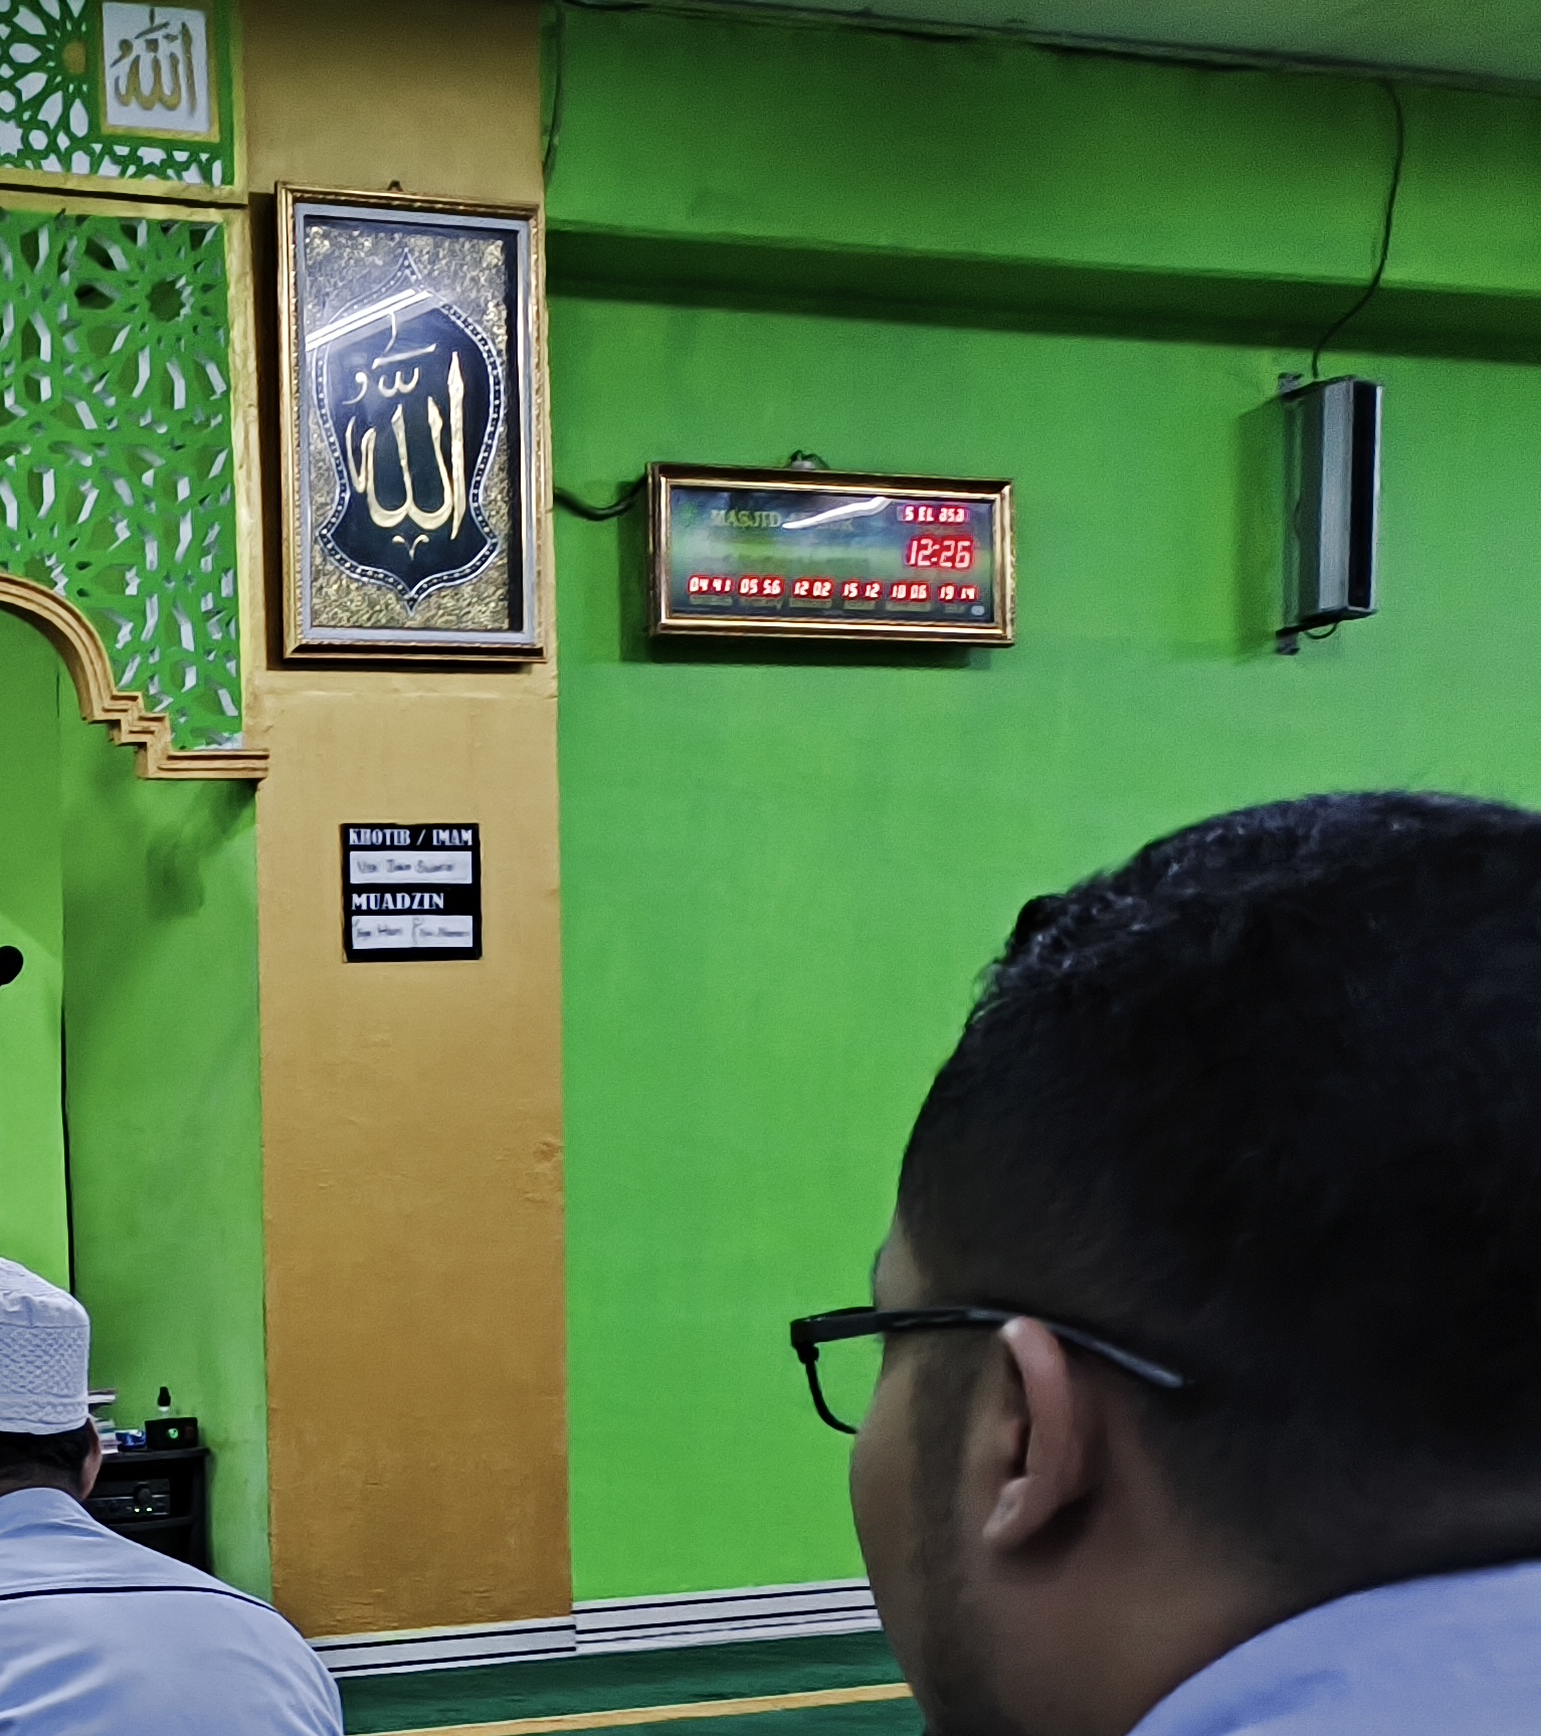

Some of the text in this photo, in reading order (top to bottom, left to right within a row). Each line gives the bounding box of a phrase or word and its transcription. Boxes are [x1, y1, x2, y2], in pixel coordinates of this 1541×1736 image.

[711, 510, 782, 528] MASJID
[908, 538, 971, 569] 12:26
[349, 828, 411, 846] KHOTIB
[432, 829, 473, 846] IMAM
[351, 893, 444, 910] MUADZIN
